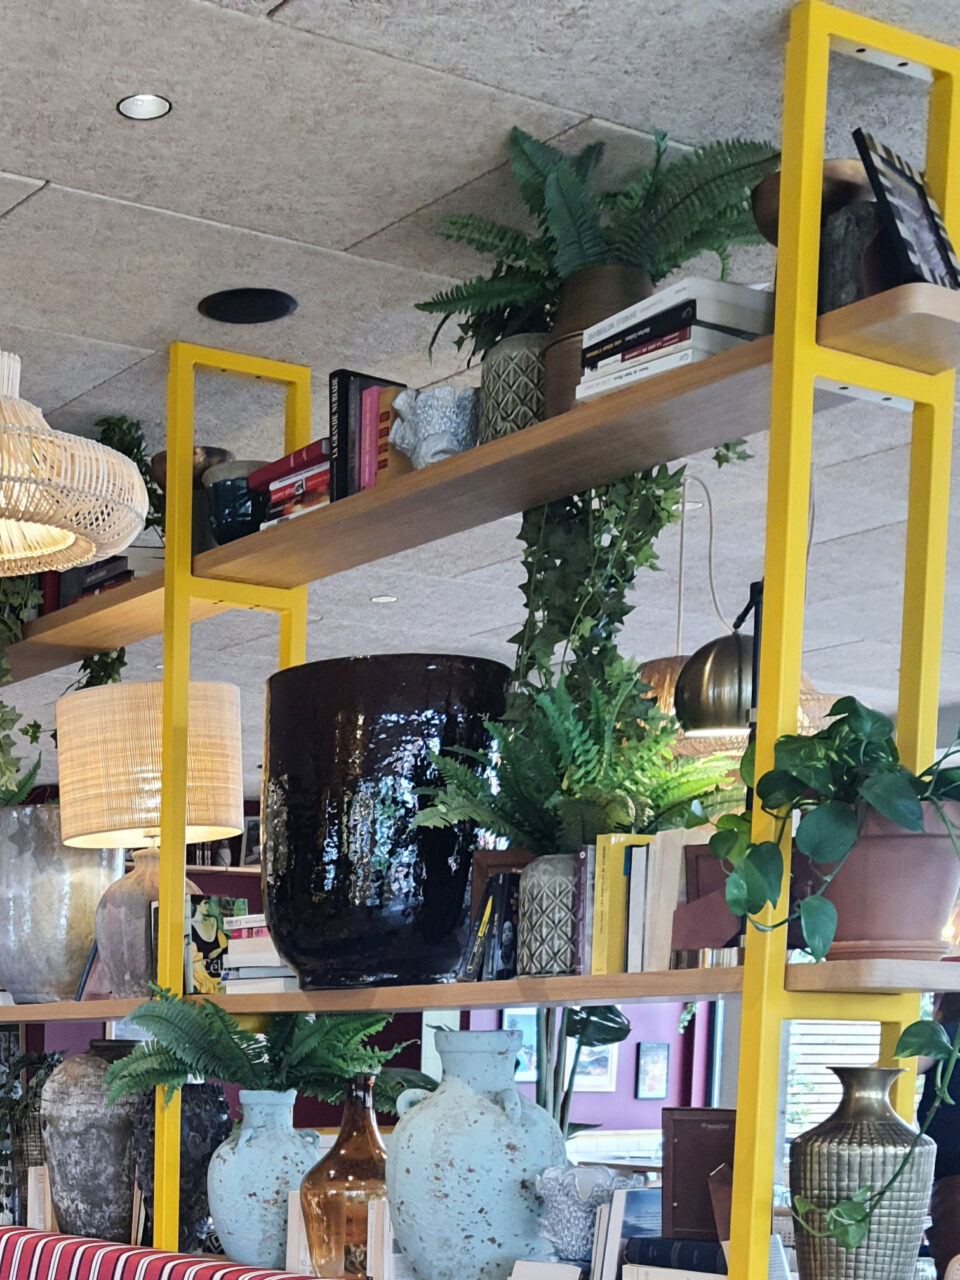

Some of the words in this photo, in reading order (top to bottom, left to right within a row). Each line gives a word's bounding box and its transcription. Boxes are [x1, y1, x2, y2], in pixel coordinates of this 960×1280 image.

[331, 413, 339, 447] GRANDE
[332, 447, 339, 458] LA
[202, 958, 233, 973] Cél
